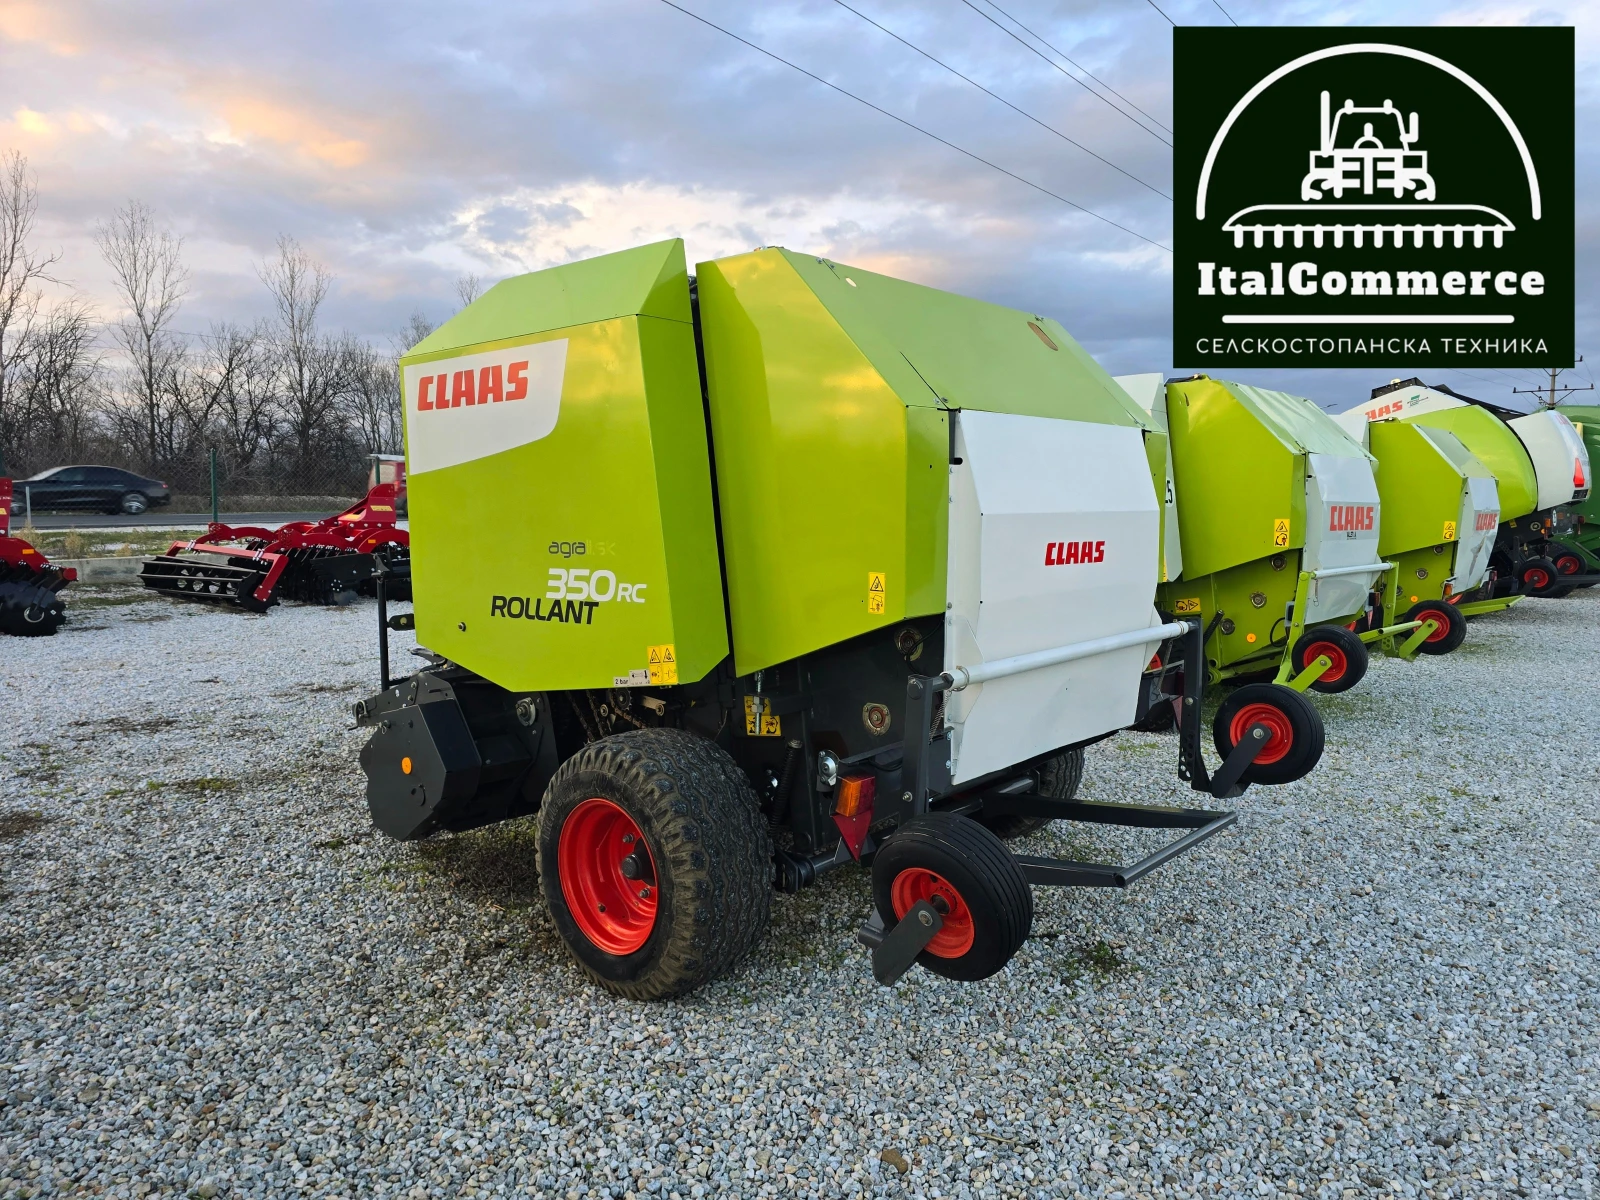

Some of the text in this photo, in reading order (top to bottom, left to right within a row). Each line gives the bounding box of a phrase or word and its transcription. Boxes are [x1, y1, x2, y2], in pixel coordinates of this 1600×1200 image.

[417, 360, 529, 412] CLAAS
[1365, 400, 1403, 421] AAS
[1165, 480, 1173, 504] 5
[1329, 505, 1374, 532] CLAAS
[1475, 513, 1498, 531] CLAAS
[1045, 540, 1105, 566] CLAAS
[546, 567, 648, 603] 350 RC
[491, 595, 600, 625] ROLLANT
